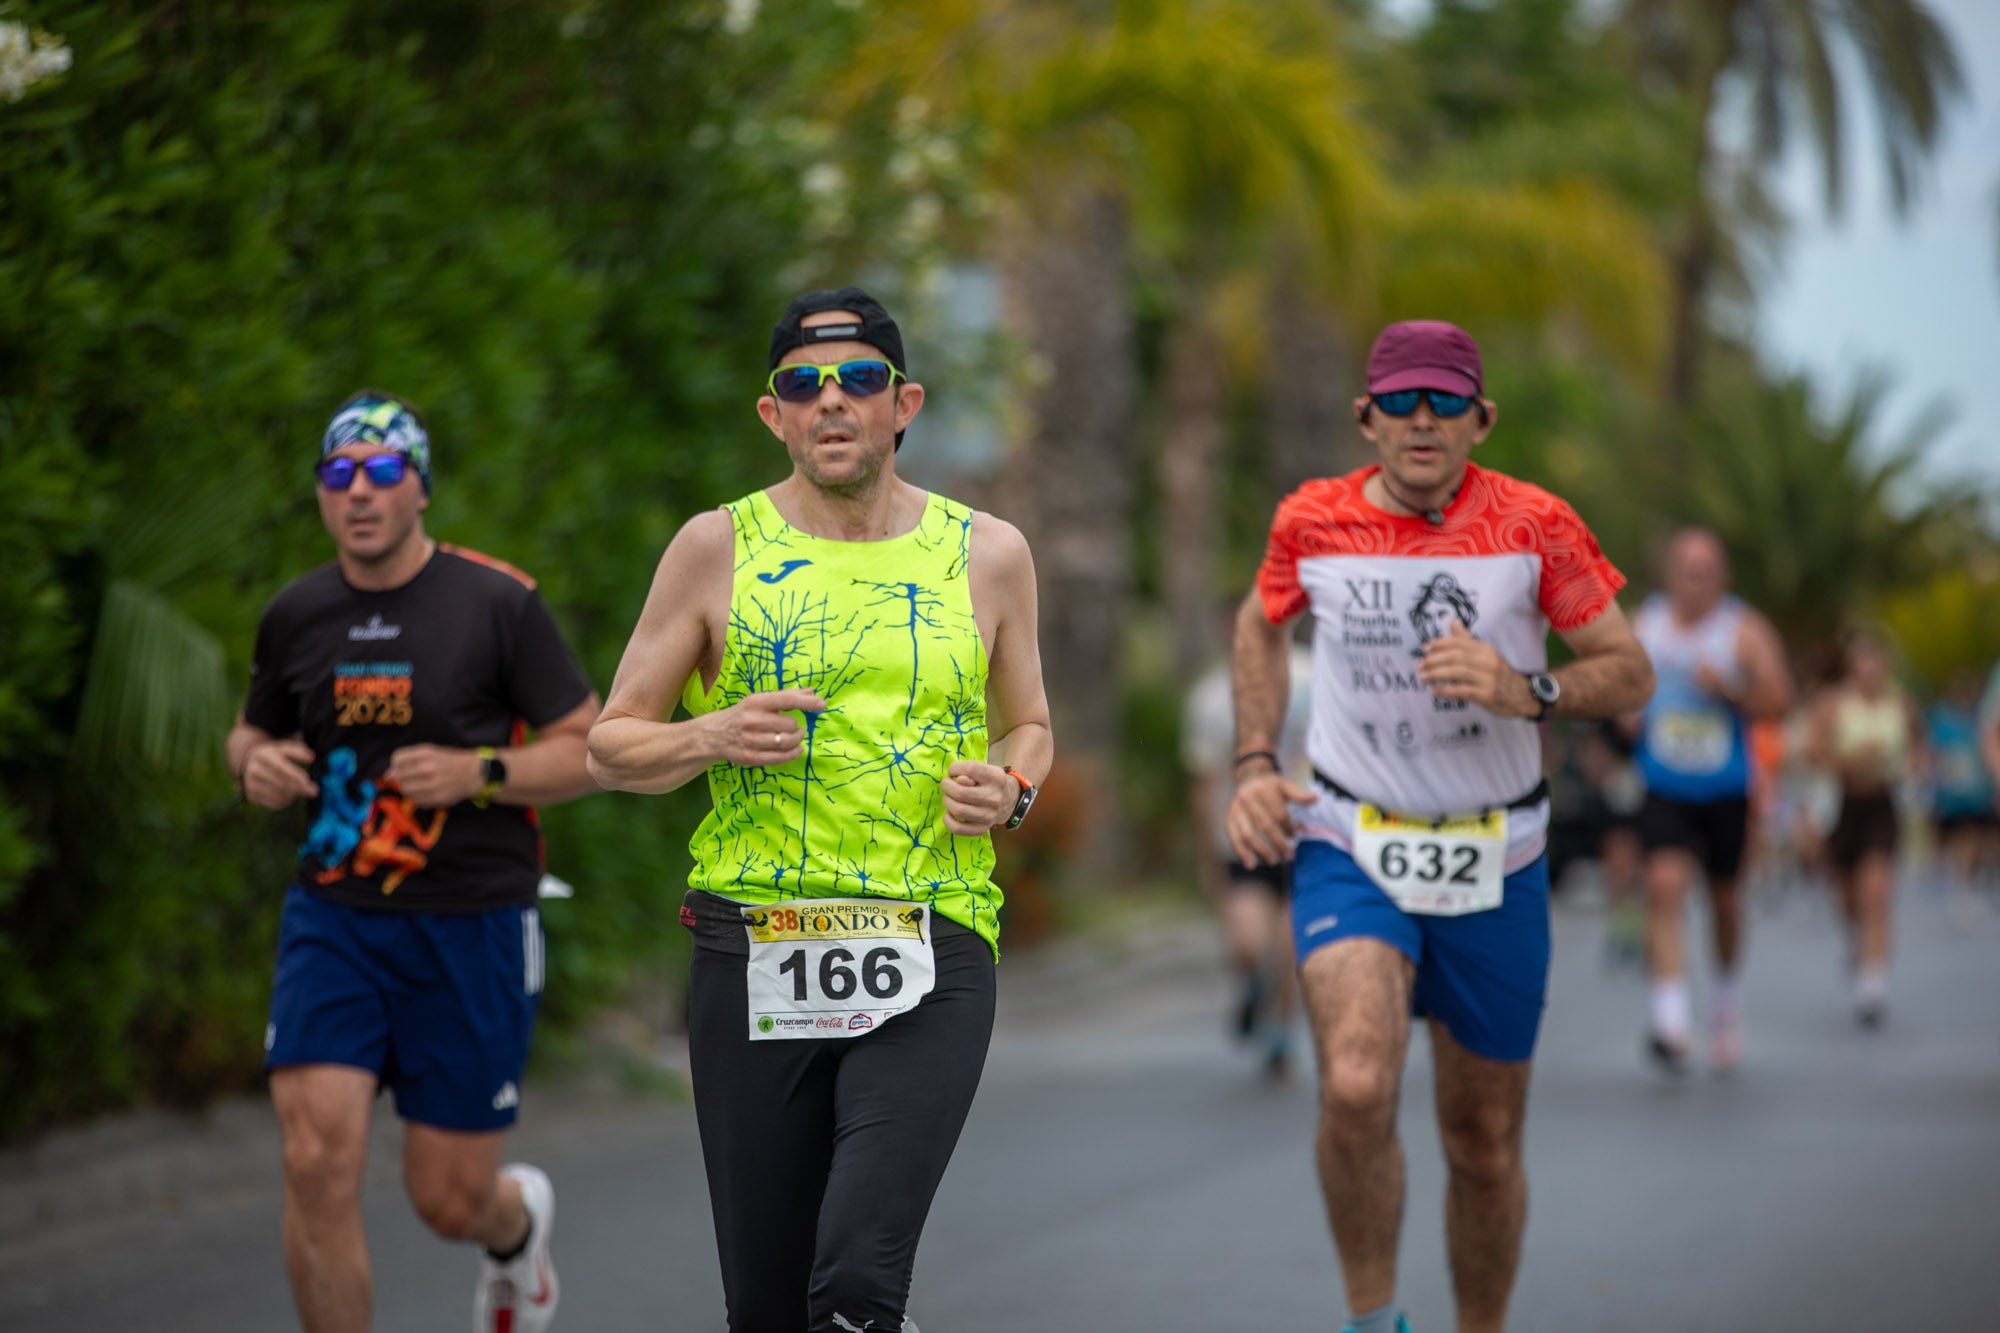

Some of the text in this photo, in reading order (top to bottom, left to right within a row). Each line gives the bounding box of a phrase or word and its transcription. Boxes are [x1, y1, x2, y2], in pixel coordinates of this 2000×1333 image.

[1345, 579, 1392, 610] XII
[334, 676, 412, 697] FONDO
[335, 697, 413, 725] 2025
[1380, 842, 1481, 885] 632
[770, 909, 799, 932] 38
[801, 906, 835, 916] GRAN
[837, 905, 880, 915] PREMIO
[800, 913, 890, 933] FONDO
[780, 946, 903, 1001] 166
[776, 1017, 814, 1026] Cruzcampo
